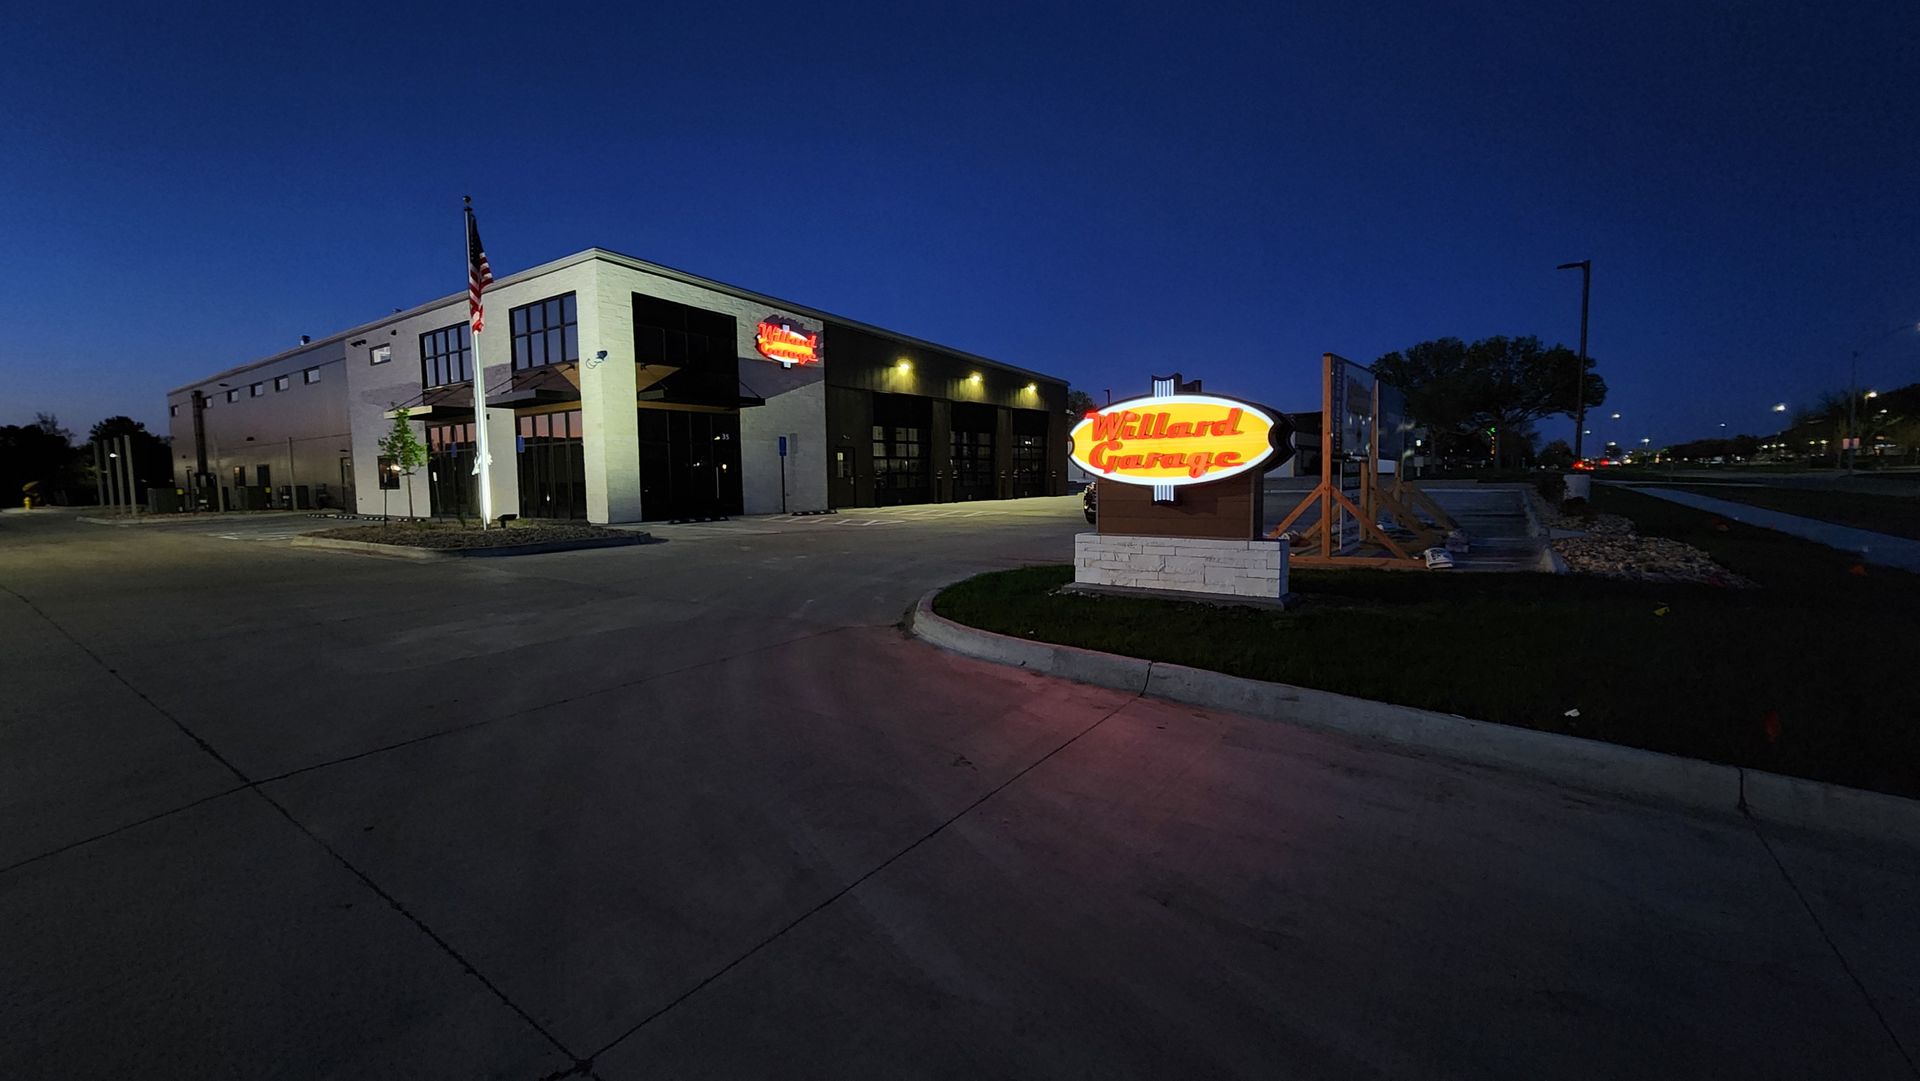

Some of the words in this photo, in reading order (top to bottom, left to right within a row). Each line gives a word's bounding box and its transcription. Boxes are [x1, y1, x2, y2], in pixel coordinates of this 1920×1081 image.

[758, 322, 817, 348] Willard
[761, 342, 818, 365] Garage
[1084, 407, 1243, 441] Willard
[1089, 441, 1246, 478] Garage
